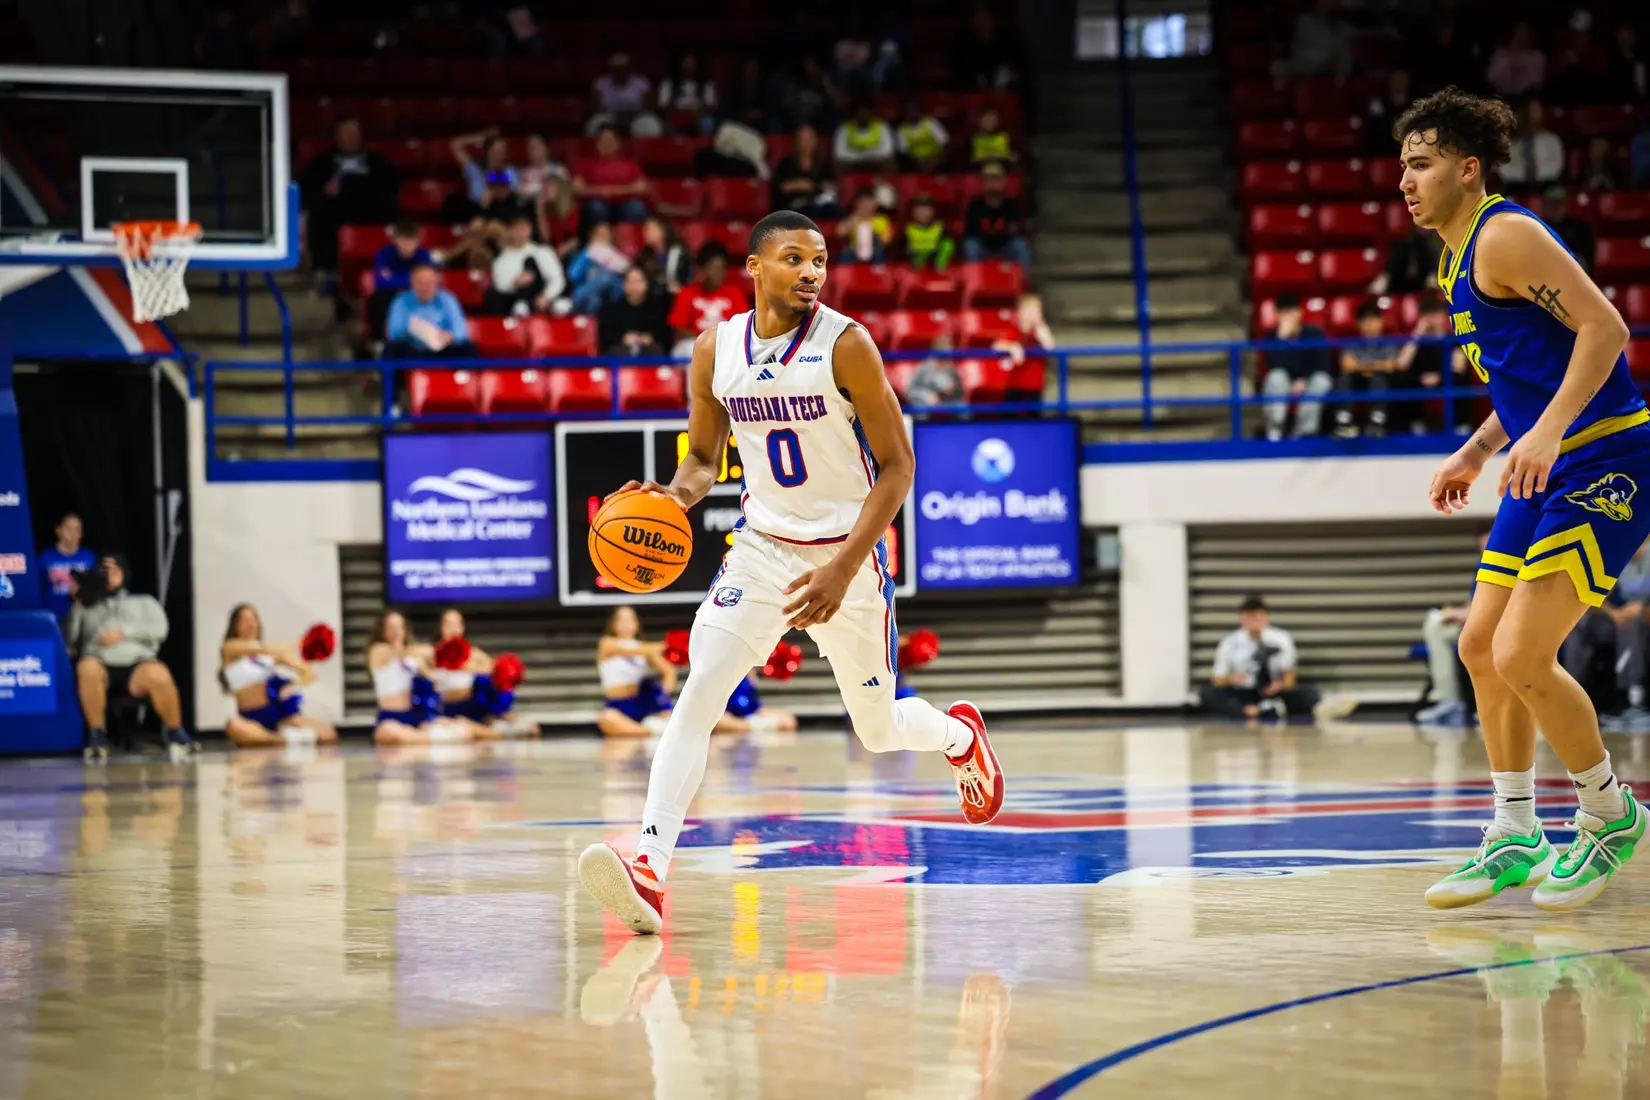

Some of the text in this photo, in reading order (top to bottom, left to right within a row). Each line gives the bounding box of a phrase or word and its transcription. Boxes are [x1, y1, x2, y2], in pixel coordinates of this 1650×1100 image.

[789, 395, 828, 421] TECH
[766, 428, 809, 488] 0
[921, 487, 1068, 526] Origin Bank
[406, 518, 534, 541] Medical Center
[624, 525, 685, 557] Wilson
